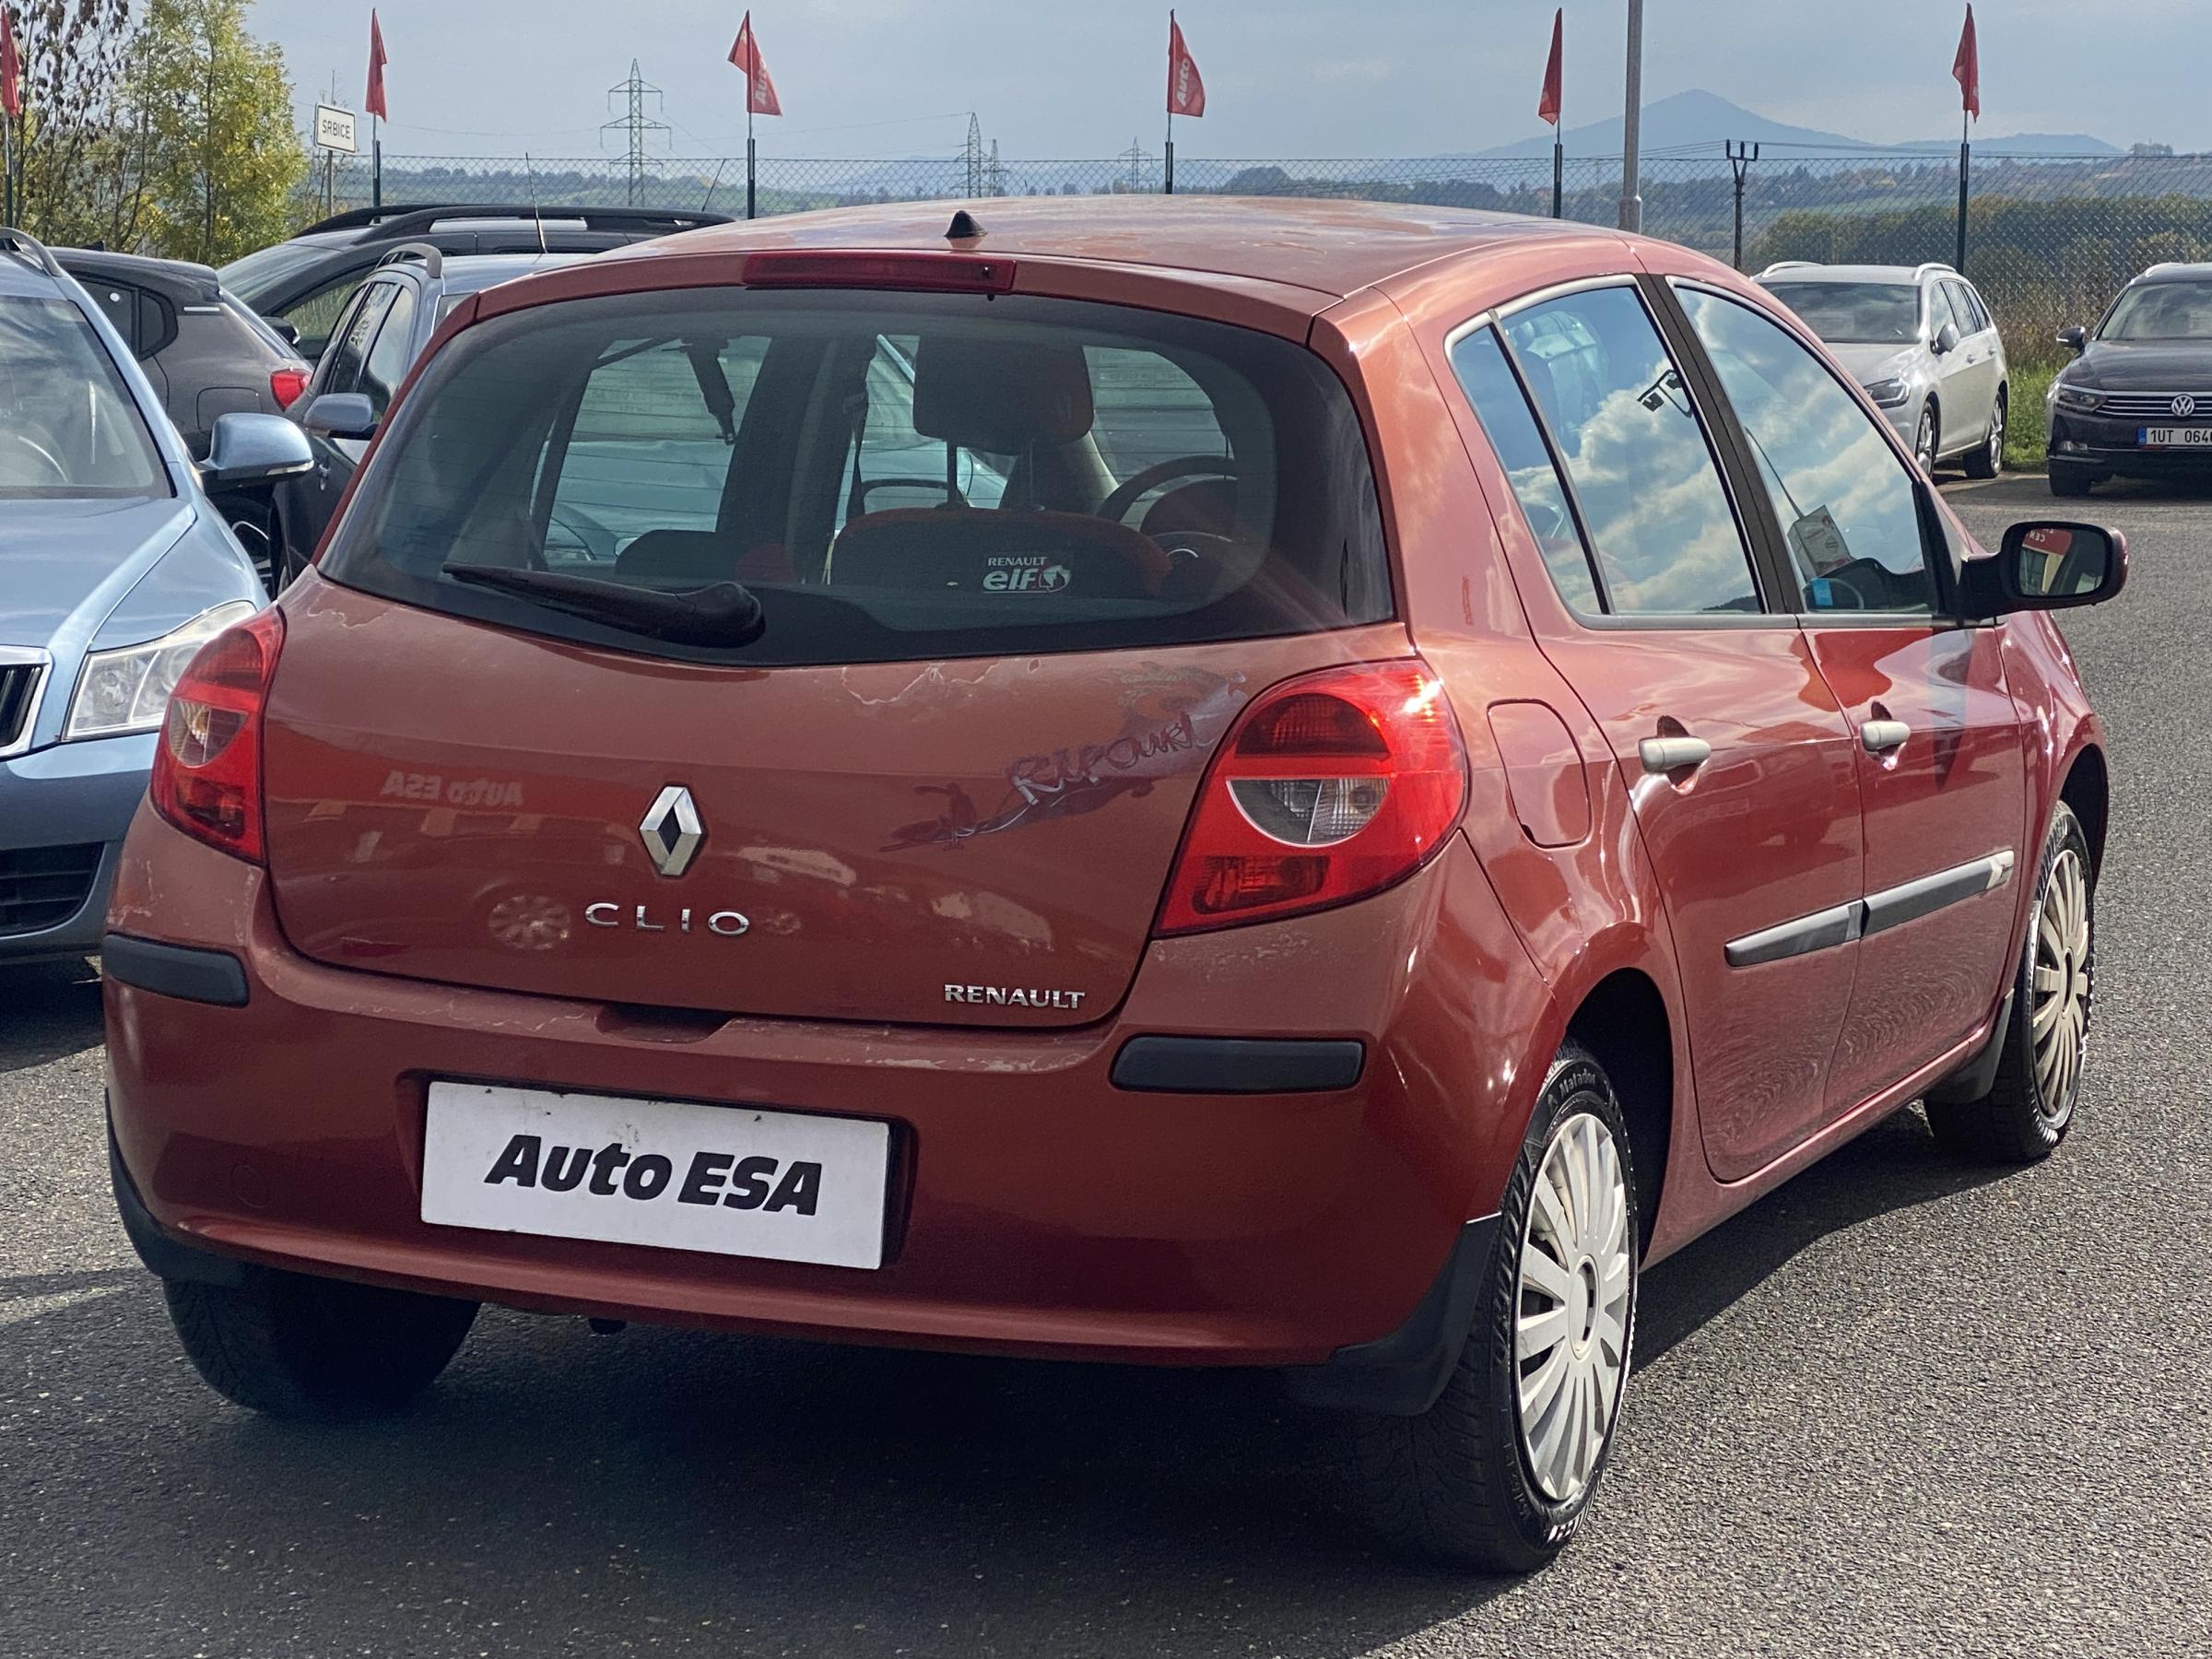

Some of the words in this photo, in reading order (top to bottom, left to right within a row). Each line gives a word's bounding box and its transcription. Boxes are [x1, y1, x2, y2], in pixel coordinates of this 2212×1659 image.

[1176, 57, 1190, 107] Auto
[322, 119, 351, 139] SRBICE
[2150, 429, 2174, 443] 1UT
[987, 557, 1047, 567] RENAULT
[982, 568, 1039, 591] elf
[584, 902, 750, 936] CLIO
[944, 983, 1086, 1010] RENAULT
[484, 1134, 673, 1200] Auto
[677, 1151, 822, 1216] ESA
